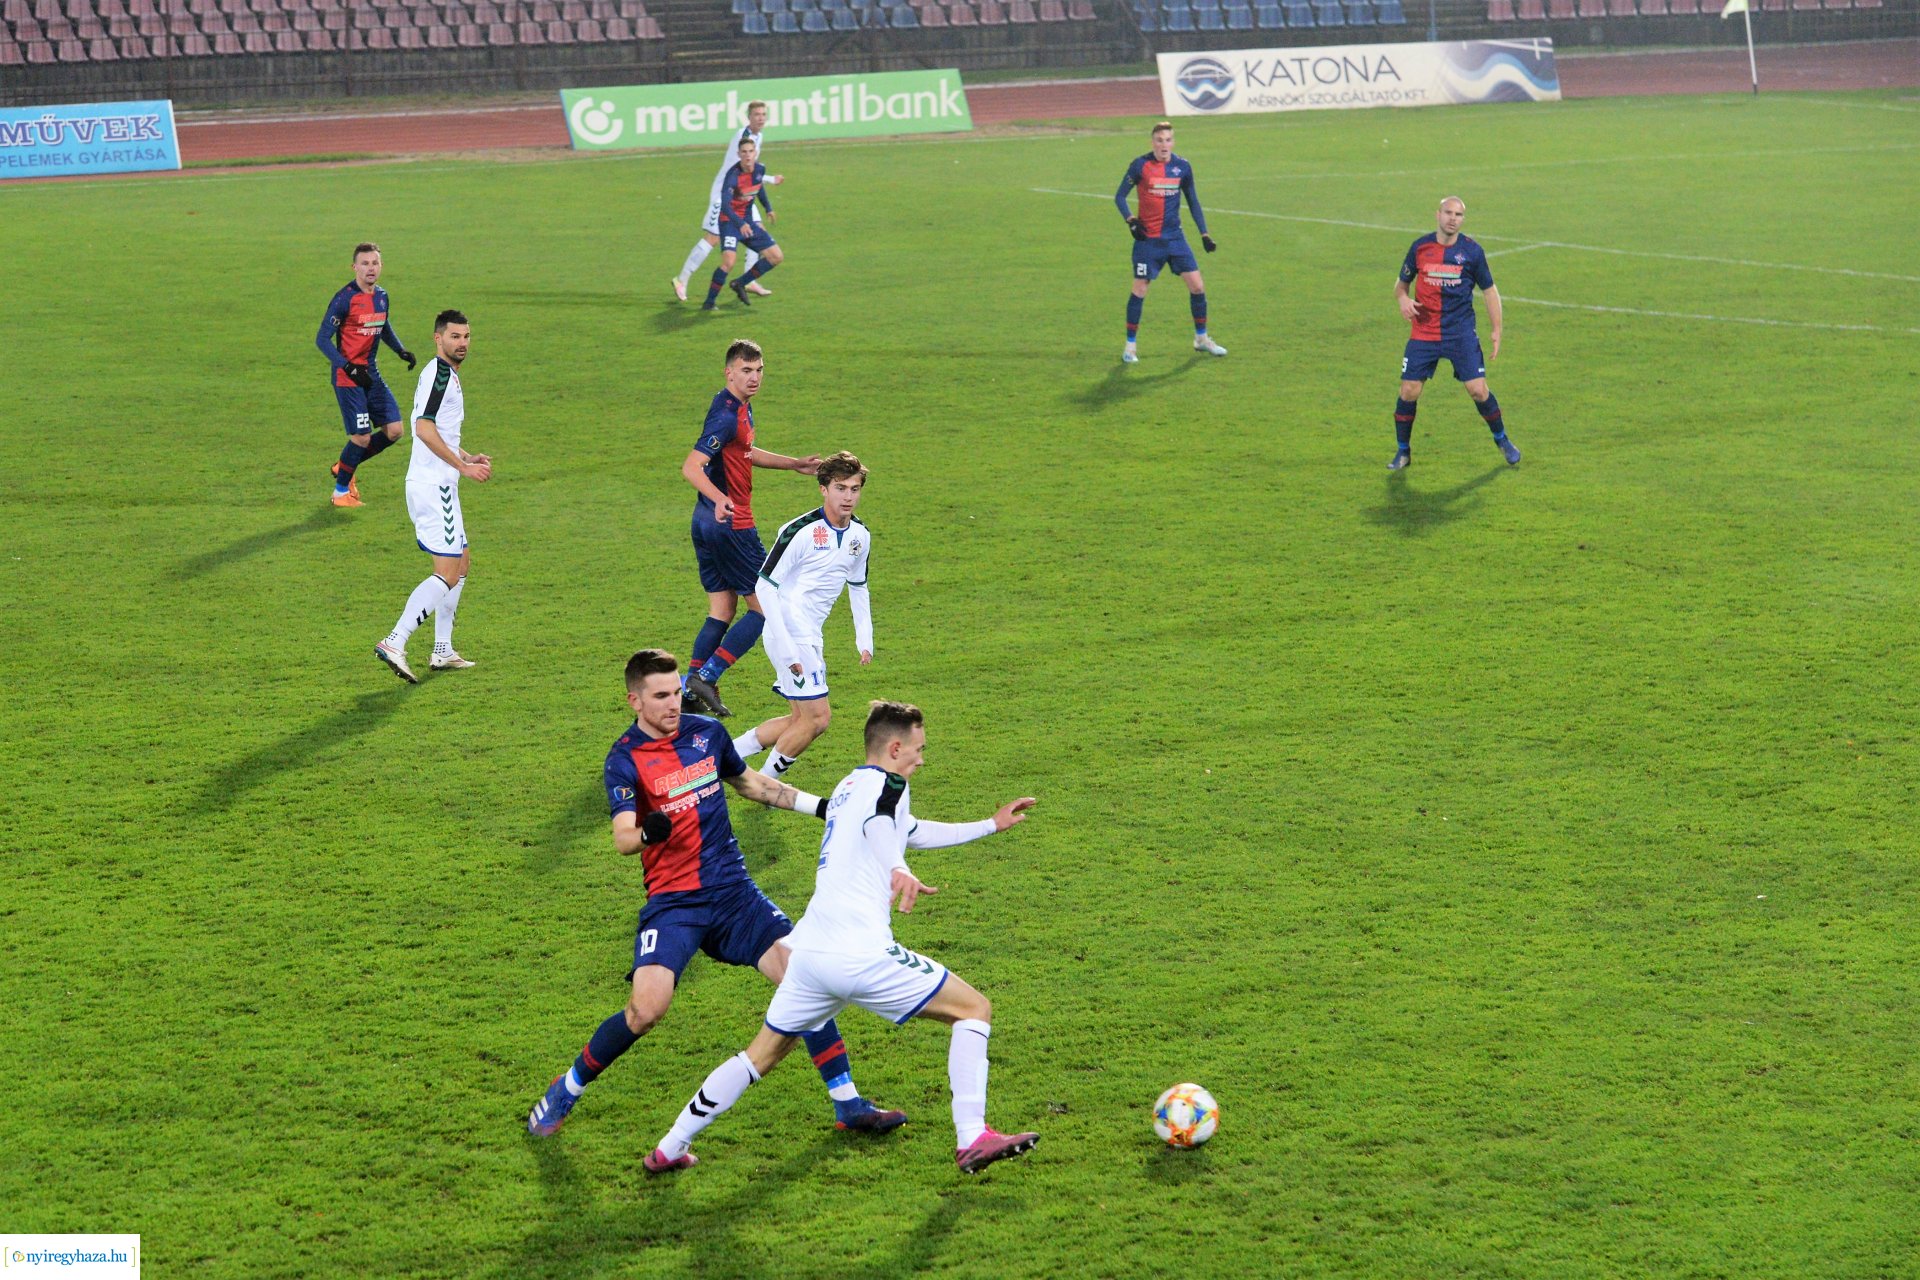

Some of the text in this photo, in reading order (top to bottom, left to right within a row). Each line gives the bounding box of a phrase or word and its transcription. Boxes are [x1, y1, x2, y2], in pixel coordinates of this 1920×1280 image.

[1245, 55, 1401, 88] KATONA
[1309, 89, 1401, 105] SZOLGÁLTATÓ
[0, 113, 163, 147] MŰVEK
[78, 147, 167, 165] GYÁRTÁSA
[1137, 263, 1147, 276] 21
[356, 413, 370, 429] 22
[640, 929, 658, 957] 10
